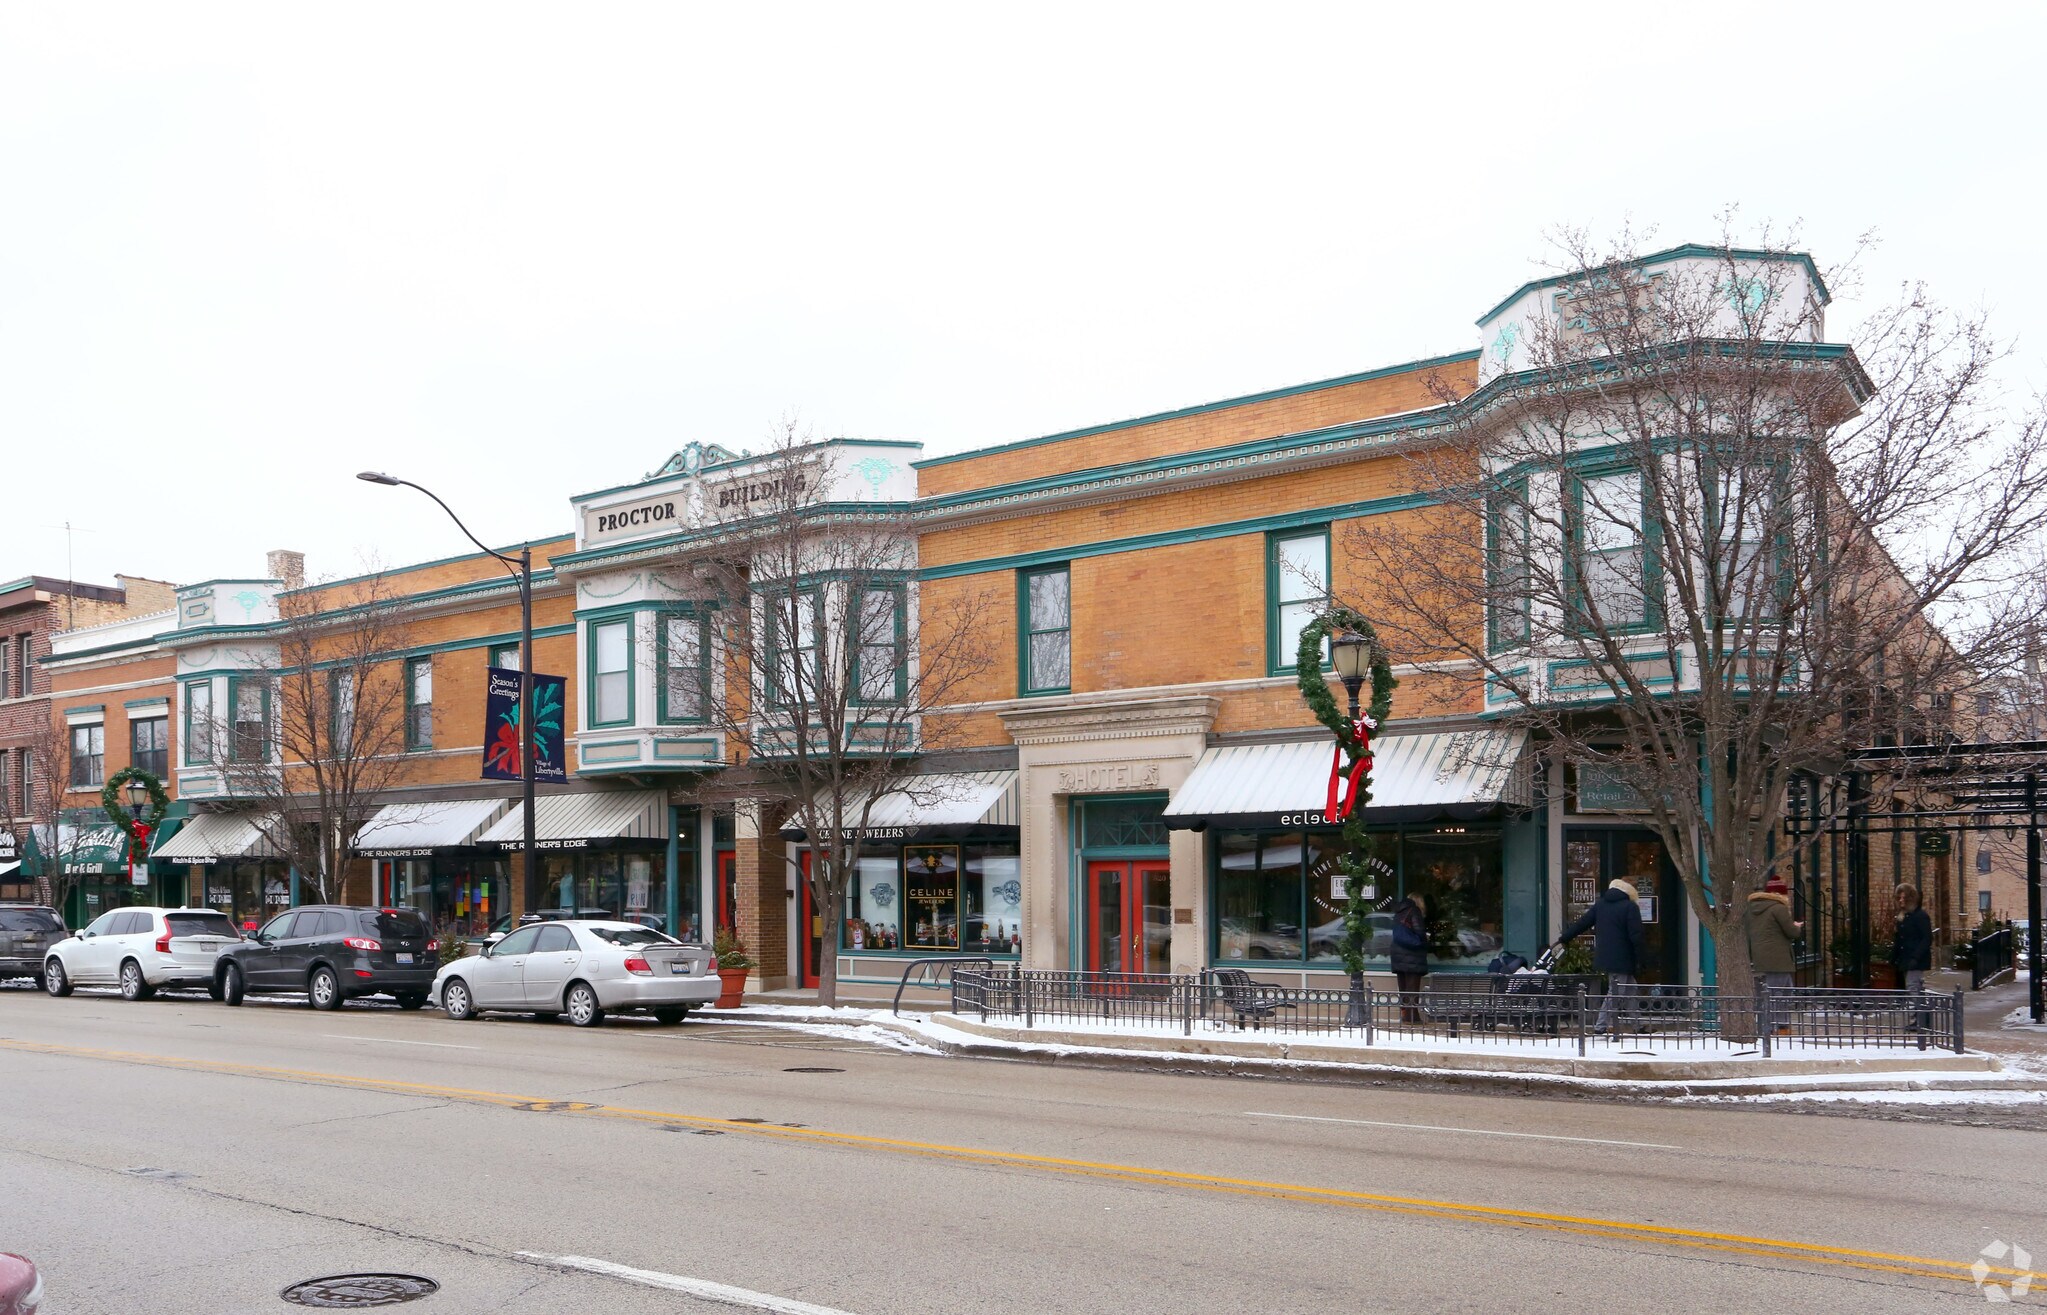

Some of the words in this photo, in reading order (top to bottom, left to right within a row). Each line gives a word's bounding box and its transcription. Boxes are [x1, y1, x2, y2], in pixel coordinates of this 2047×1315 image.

[598, 502, 676, 533] PROCTOR
[718, 474, 807, 508] BUILDING
[492, 674, 519, 688] Season's
[489, 684, 520, 701] Greetings
[534, 765, 564, 777] Libertyville
[1074, 764, 1141, 791] HOTEL
[854, 827, 904, 839] JWELERS
[518, 841, 561, 849] RNER'S
[563, 839, 588, 848] EDGE
[375, 849, 411, 857] RUNNER'S
[412, 848, 433, 856] EDGE
[204, 856, 217, 864] Shop
[86, 862, 103, 874] Grill
[1312, 860, 1332, 878] FINE
[1366, 857, 1394, 877] OODS
[909, 888, 954, 897] CELINE
